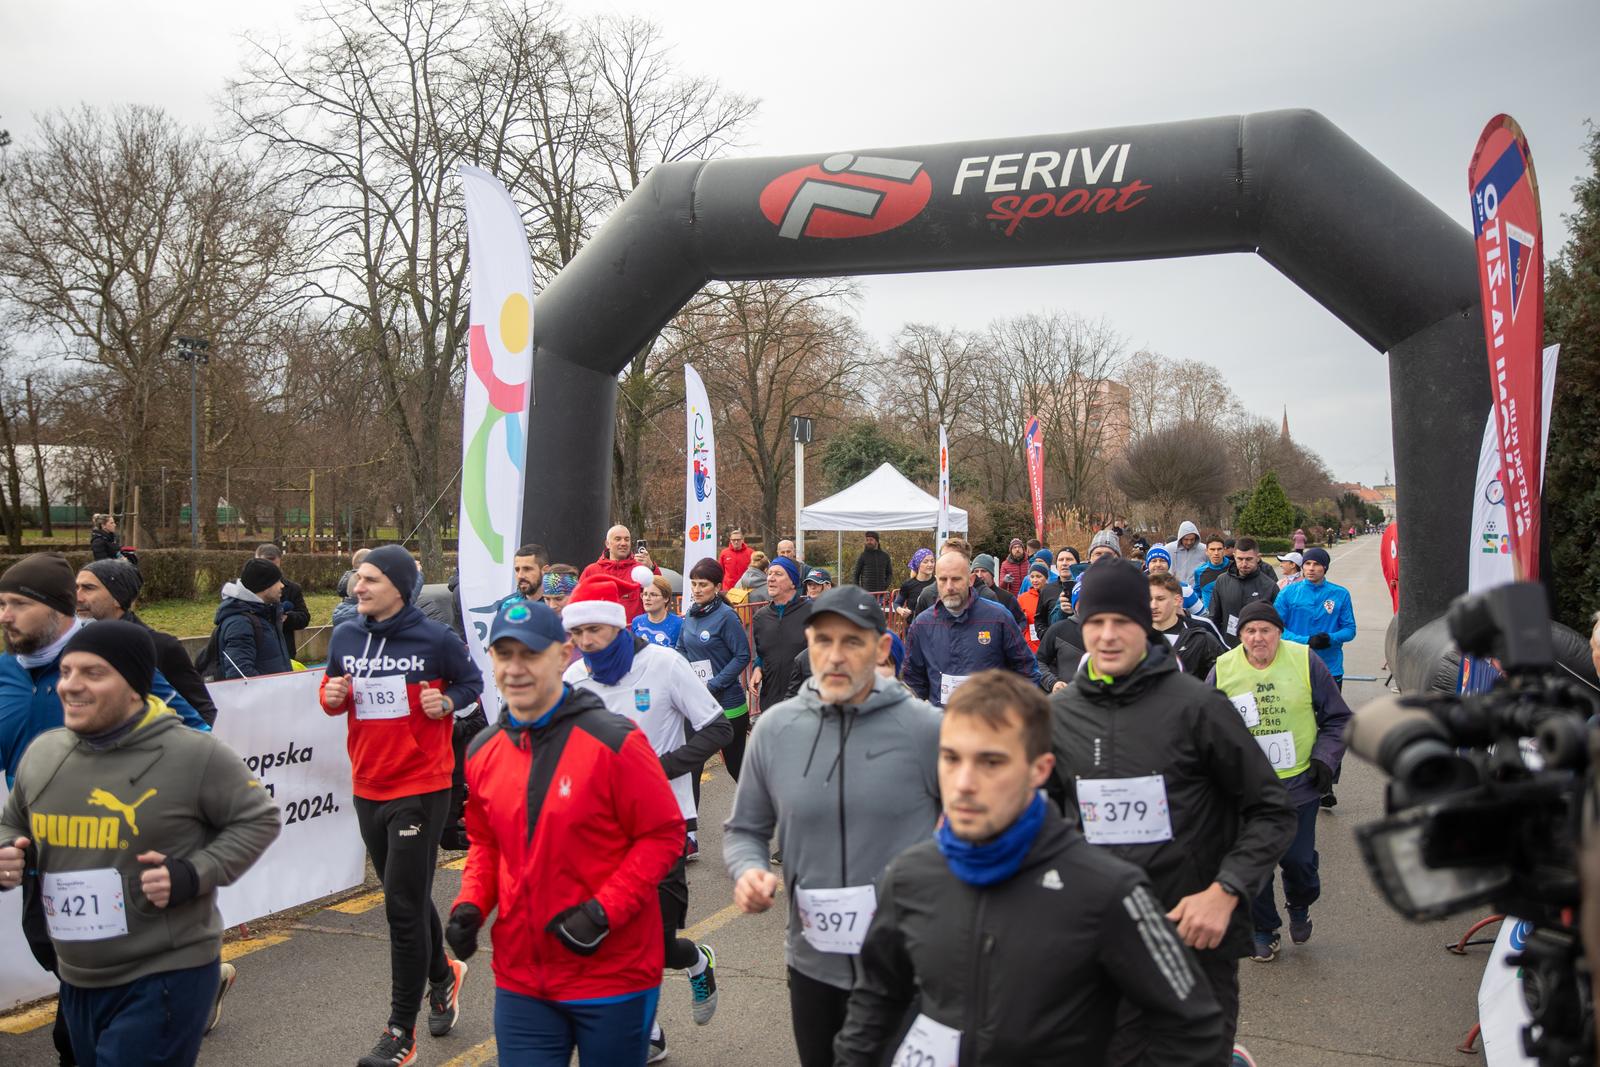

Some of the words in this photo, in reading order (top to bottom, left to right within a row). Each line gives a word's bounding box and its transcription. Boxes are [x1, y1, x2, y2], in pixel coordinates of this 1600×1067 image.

[952, 143, 1131, 196] FERIVI
[986, 179, 1153, 237] sport
[342, 655, 425, 674] Reebok
[367, 691, 396, 705] 183
[243, 742, 313, 777] opska
[285, 792, 340, 825] 2024.
[1104, 801, 1148, 822] 379
[31, 812, 120, 848] PUMA
[61, 894, 99, 917] 421
[815, 911, 857, 933] 397
